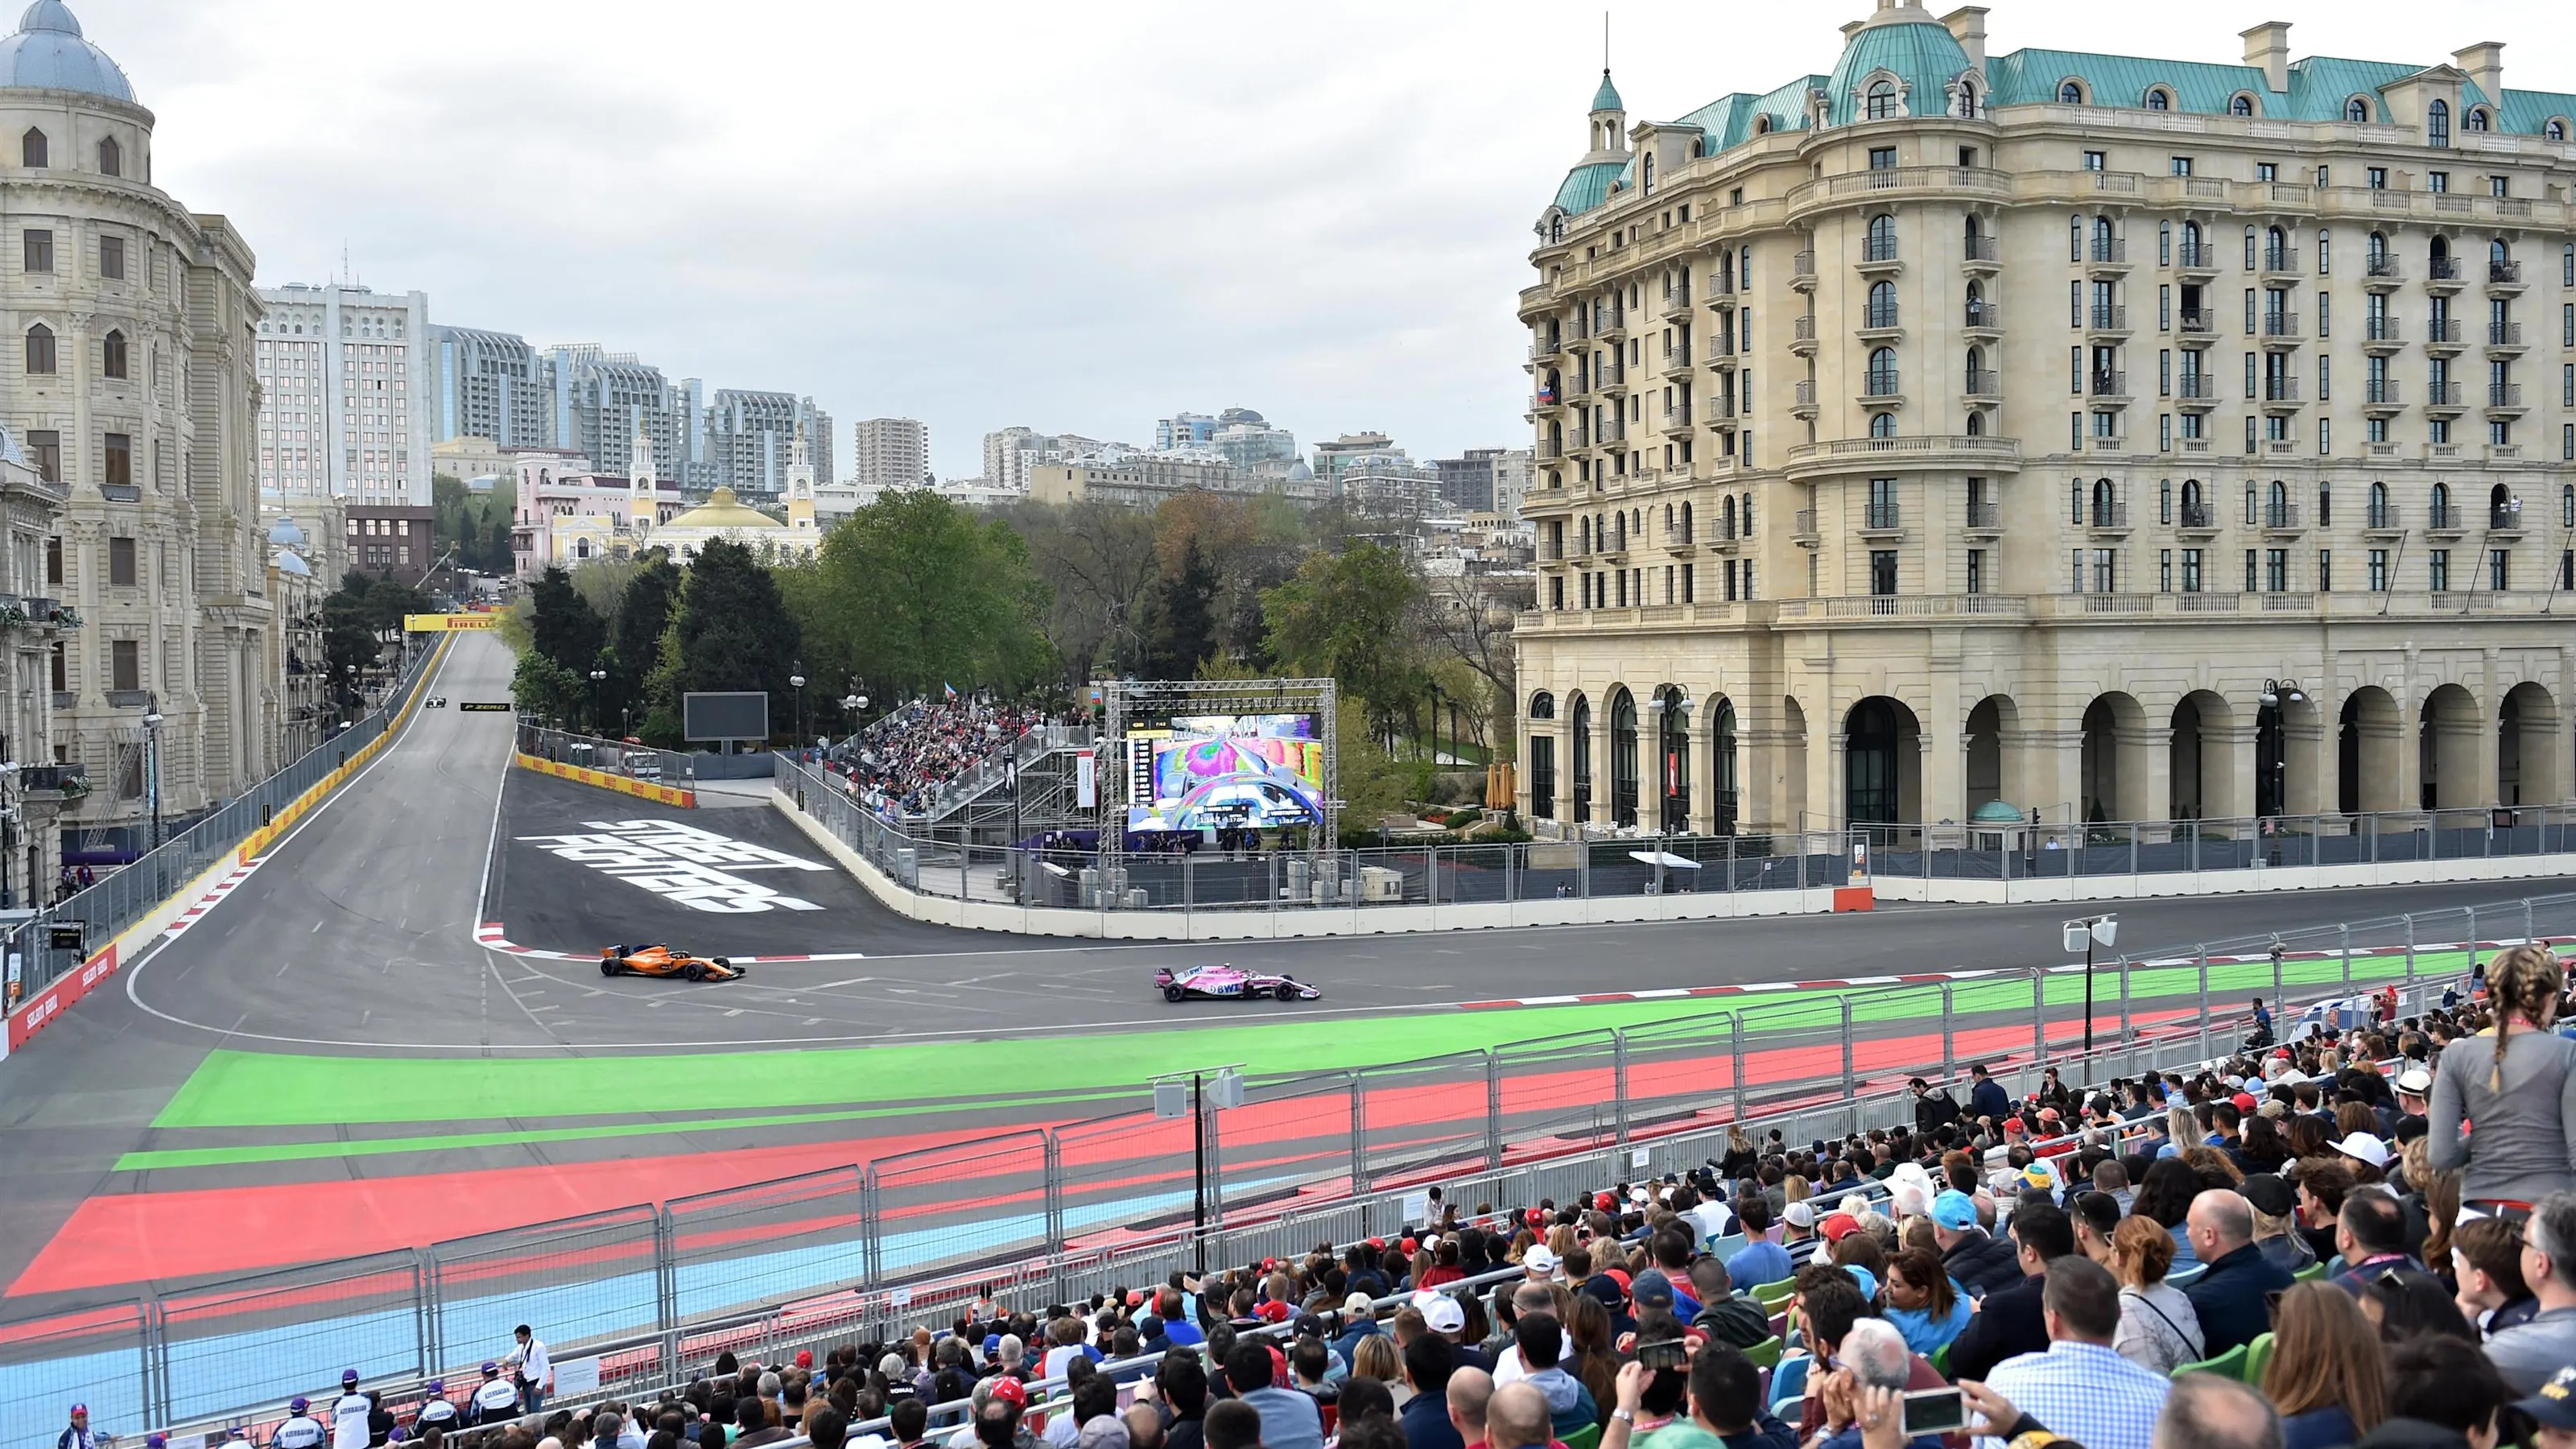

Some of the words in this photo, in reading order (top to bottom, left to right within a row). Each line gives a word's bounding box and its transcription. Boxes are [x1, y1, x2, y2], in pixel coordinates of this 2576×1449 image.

[447, 617, 495, 629] PIRELL
[579, 819, 836, 871] STREET
[513, 834, 828, 914] FIGHTERS
[1190, 966, 1203, 975] BWT
[10, 982, 19, 993] F
[1217, 983, 1240, 993] BWT
[485, 1387, 510, 1399] AZERBAIJAN
[340, 1404, 367, 1415] AZERBAIJAN
[427, 1409, 452, 1420] AZERBAIJAN
[285, 1428, 314, 1438] AZERBAIJAN
